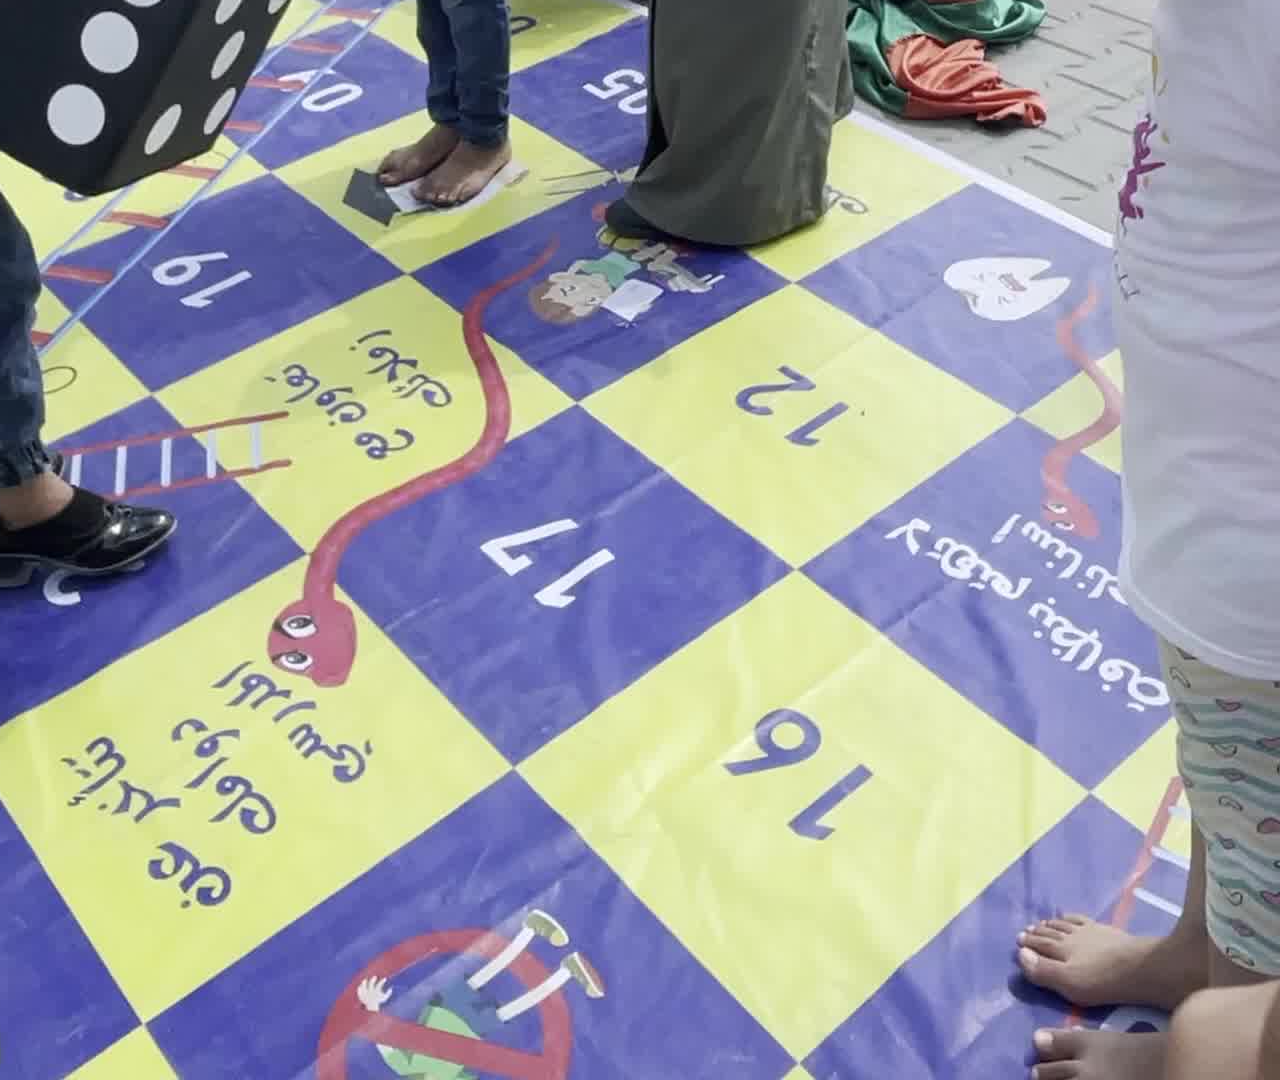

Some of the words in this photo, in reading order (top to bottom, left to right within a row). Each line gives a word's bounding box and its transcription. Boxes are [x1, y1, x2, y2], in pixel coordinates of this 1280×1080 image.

[151, 250, 253, 309] 19
[264, 363, 367, 427] تعاون
[354, 432, 415, 460] مع
[348, 329, 452, 407] زملائك
[735, 364, 850, 447] 12
[480, 518, 615, 609] 17
[884, 518, 932, 555] لا
[925, 537, 1032, 600] تهتم
[1028, 597, 1171, 712] بنظافة
[211, 660, 373, 783] المدرسي
[171, 718, 277, 834] دوامك
[723, 706, 874, 842] 16
[147, 841, 232, 908] عن
